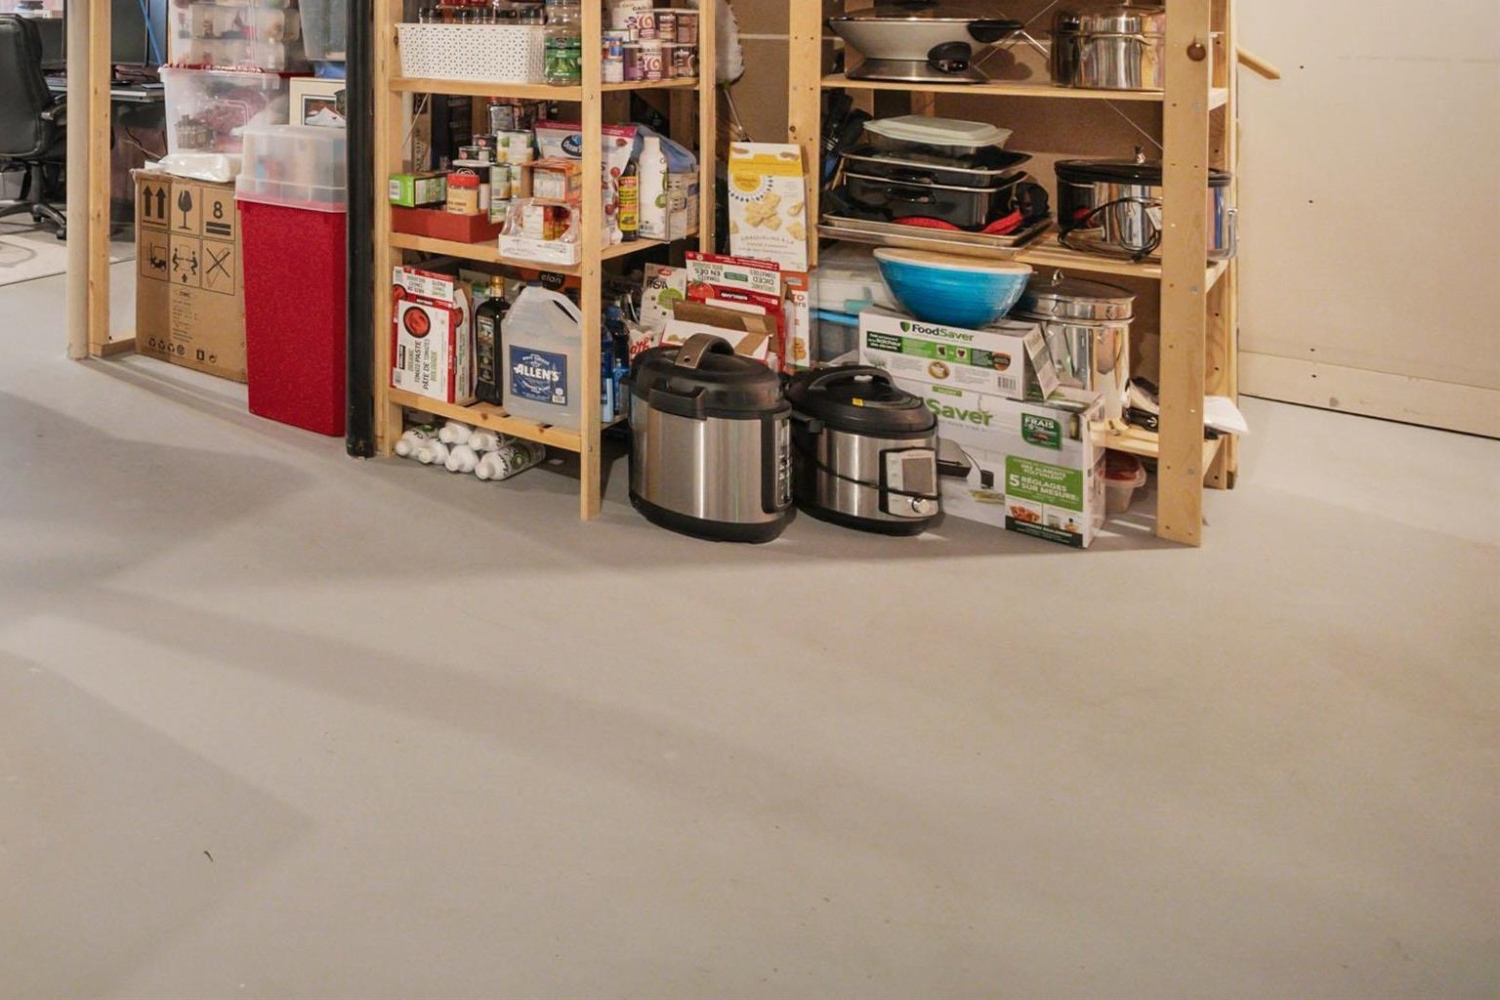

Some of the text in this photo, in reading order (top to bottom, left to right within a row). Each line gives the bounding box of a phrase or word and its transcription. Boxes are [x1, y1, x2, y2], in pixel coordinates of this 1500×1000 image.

[212, 200, 224, 220] 8
[911, 323, 975, 342] FoodSaver
[414, 339, 422, 363] PASTE
[513, 363, 561, 382] ALLEN'S
[1024, 416, 1055, 430] FRAIS
[1008, 473, 1020, 488] 5
